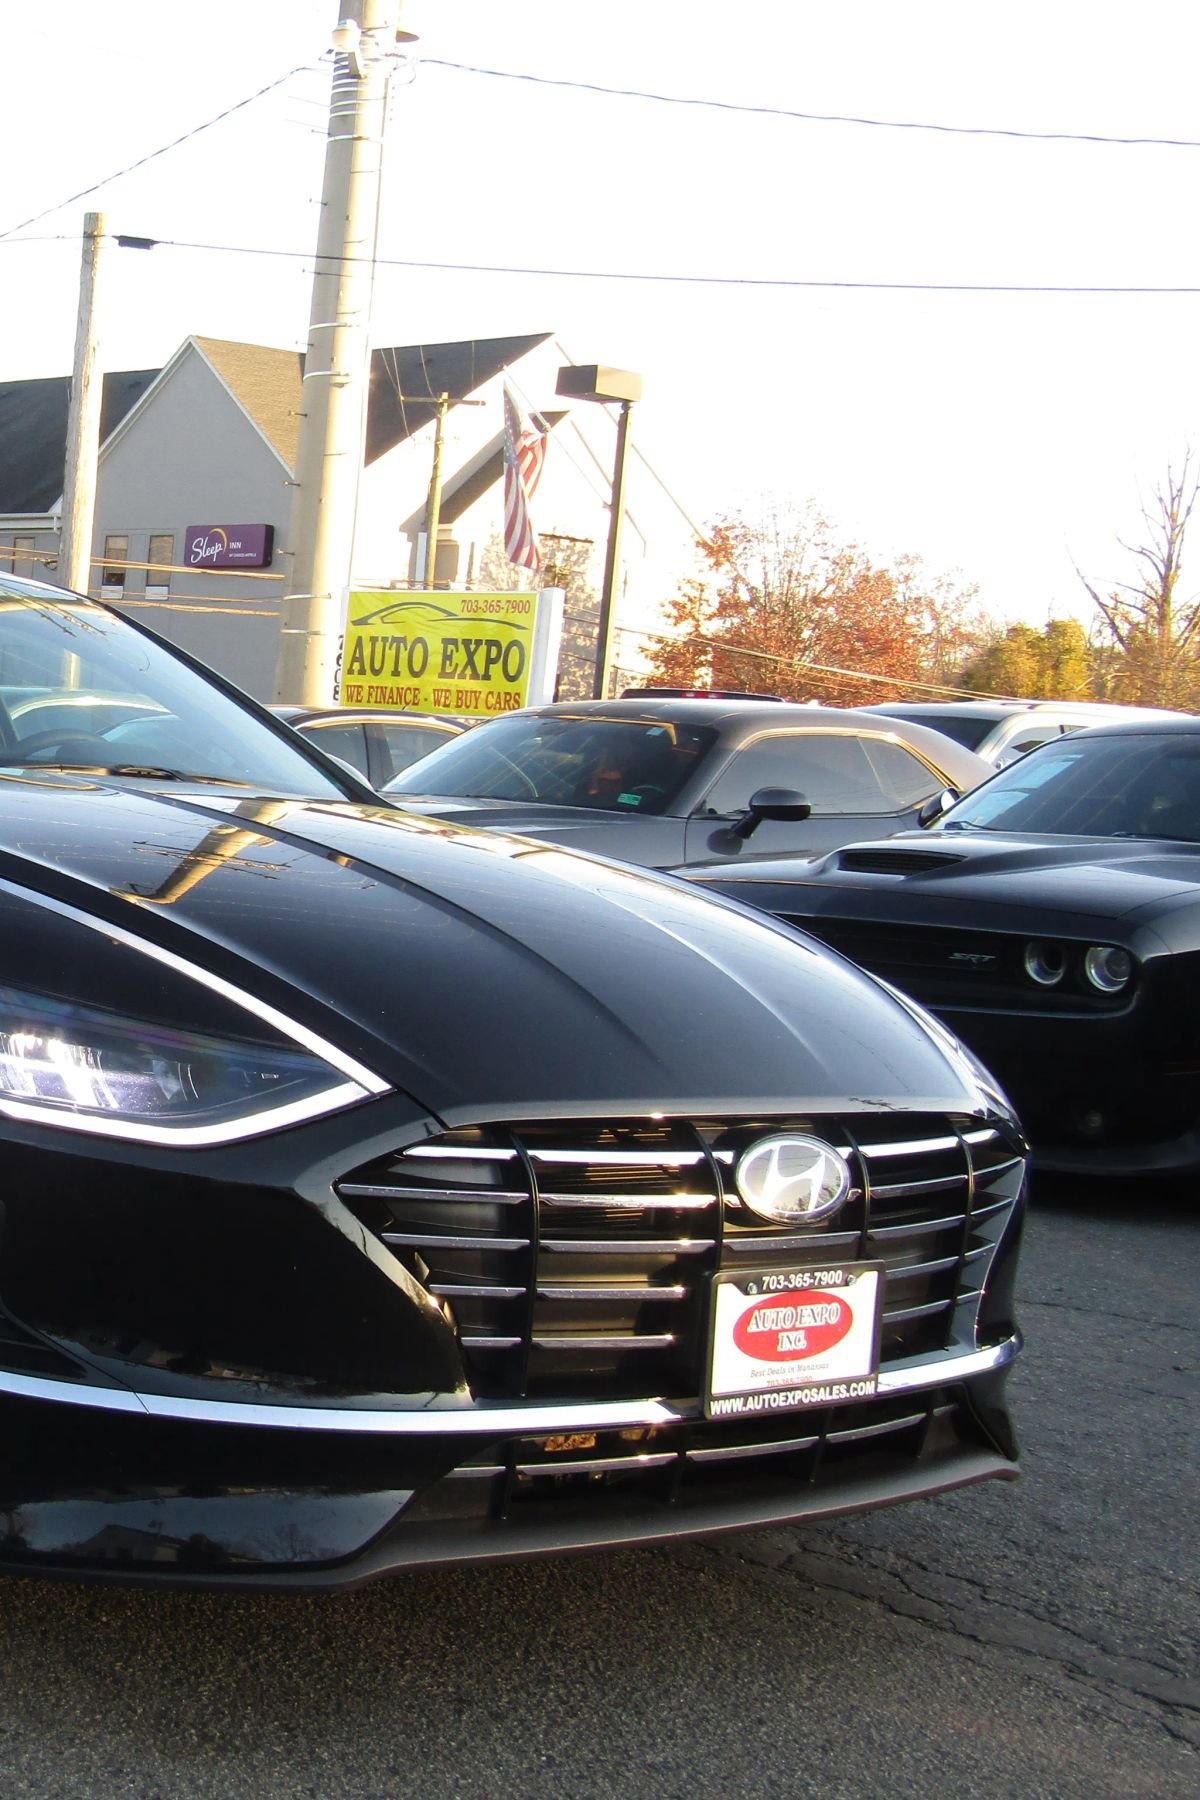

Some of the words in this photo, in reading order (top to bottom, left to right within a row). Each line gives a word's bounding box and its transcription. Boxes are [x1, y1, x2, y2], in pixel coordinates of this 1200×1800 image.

[190, 536, 223, 563] Sleep
[461, 599, 530, 614] 703-365-7900
[347, 635, 429, 678] AUTO
[438, 638, 526, 683] EXPO
[346, 684, 364, 704] WE
[367, 685, 421, 706] FINANCE
[432, 688, 451, 707] WE
[455, 689, 481, 709] BUY
[486, 691, 521, 711] CARS
[948, 952, 996, 964] SRT
[762, 1270, 843, 1291] 703-365-7900
[747, 1307, 795, 1332] AUTO
[796, 1303, 841, 1327] EXPO
[777, 1330, 807, 1351] INC.
[709, 1380, 876, 1415] WWW.AUTOEXPOSALES.COM
